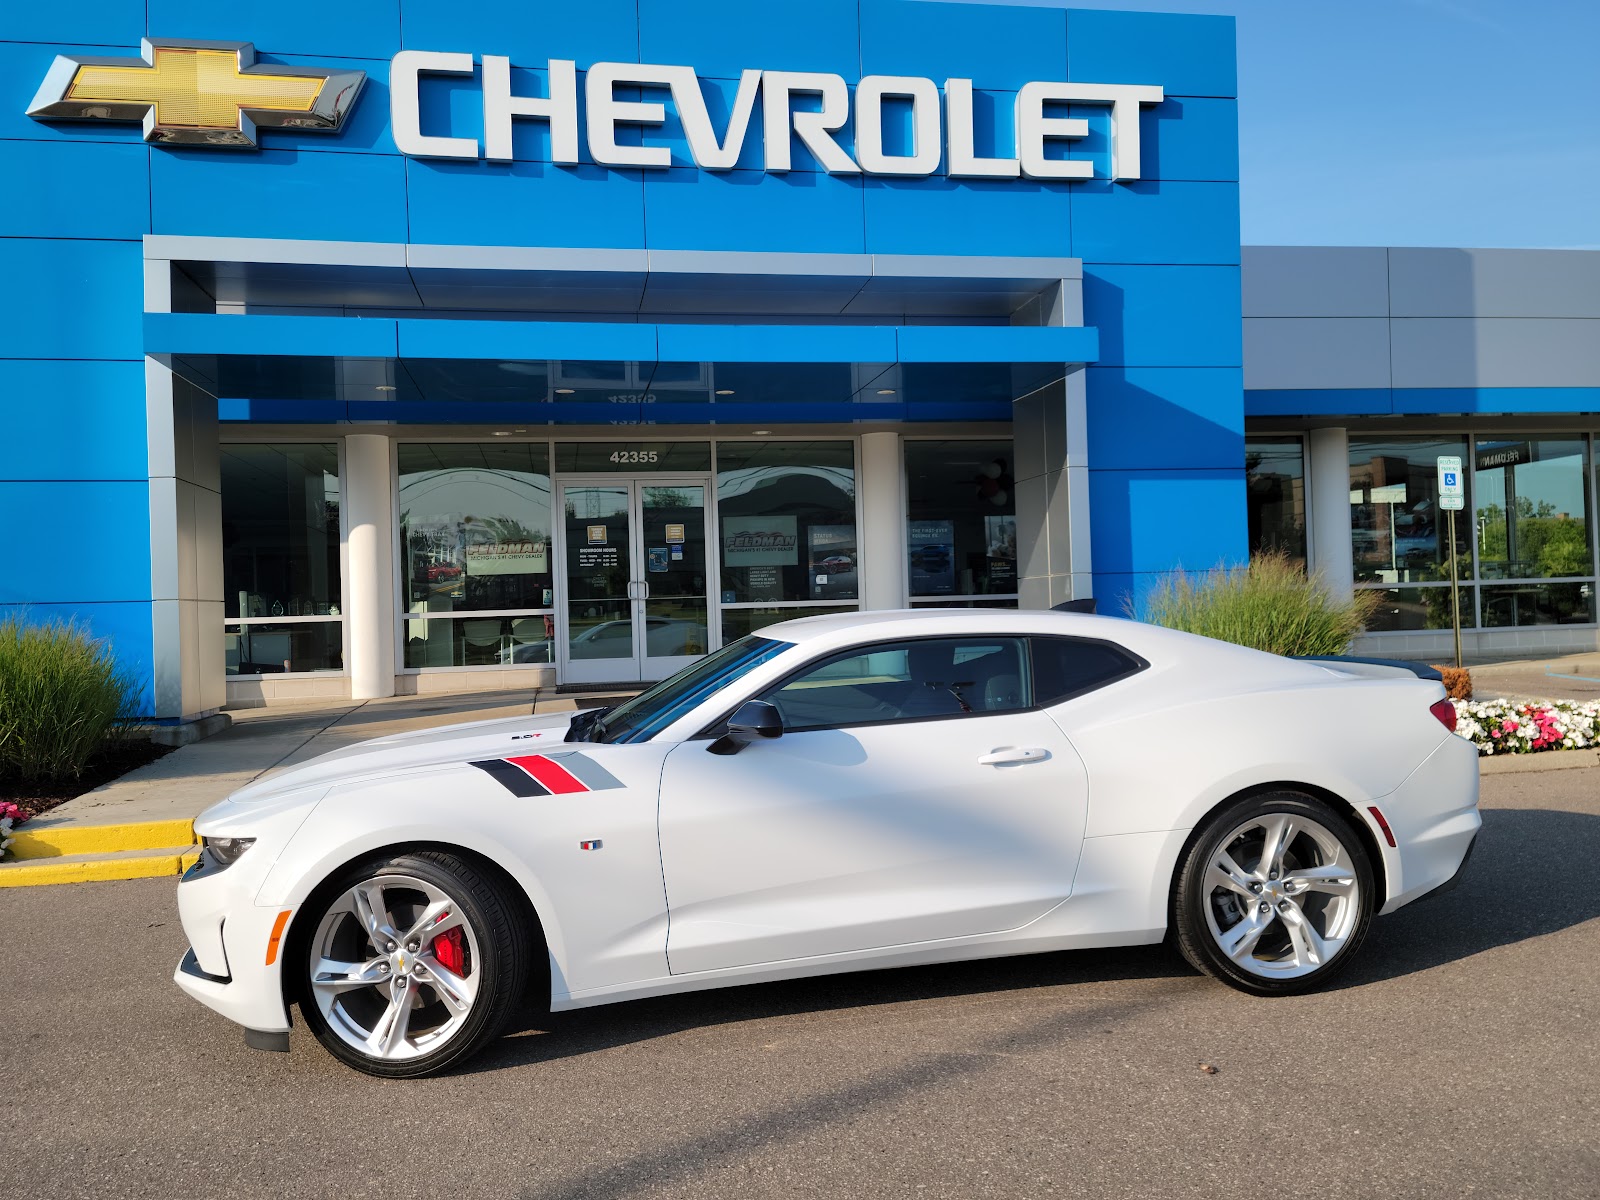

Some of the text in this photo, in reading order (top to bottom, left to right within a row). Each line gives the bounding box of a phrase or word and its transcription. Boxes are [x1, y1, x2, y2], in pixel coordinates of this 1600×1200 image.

[389, 50, 1164, 183] CHEVROLET
[609, 451, 658, 463] 42355
[468, 541, 546, 555] FELDMAN
[725, 535, 797, 548] FELDMAN
